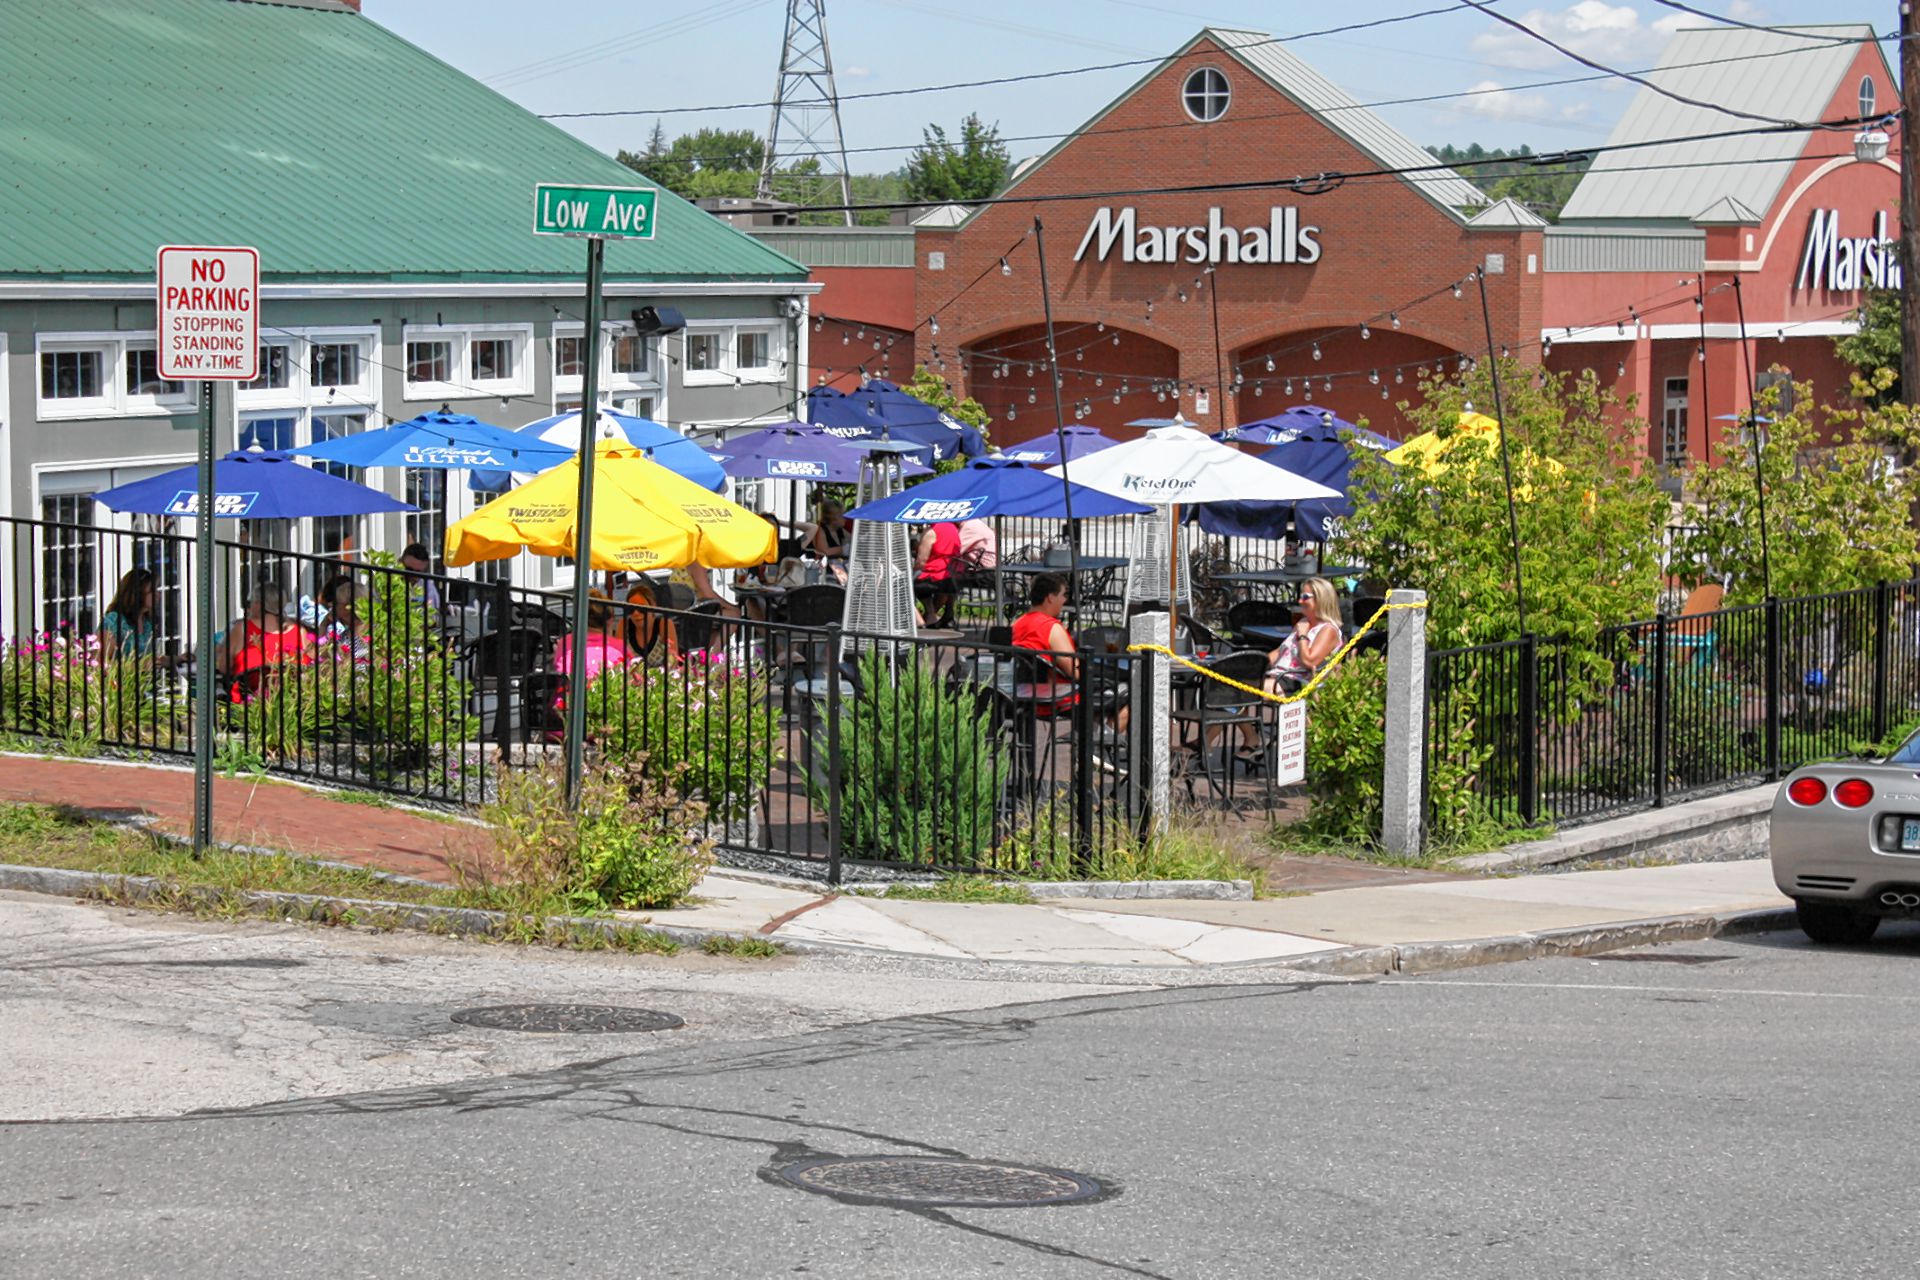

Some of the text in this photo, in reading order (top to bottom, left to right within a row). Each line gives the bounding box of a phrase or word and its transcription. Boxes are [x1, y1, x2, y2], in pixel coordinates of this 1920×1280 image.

[543, 191, 648, 232] Low Ave
[1072, 206, 1322, 264] Marshalls
[1796, 208, 1902, 291] Marsh
[191, 258, 226, 283] NO
[166, 286, 250, 312] PARKING
[172, 316, 245, 332] STOPPING
[172, 335, 245, 351] STANDING
[172, 354, 244, 370] ANY TIME
[404, 453, 505, 466] ULTRA
[1122, 474, 1197, 492] Ketel One
[901, 508, 974, 519] LIGHT
[920, 501, 972, 510] BUD
